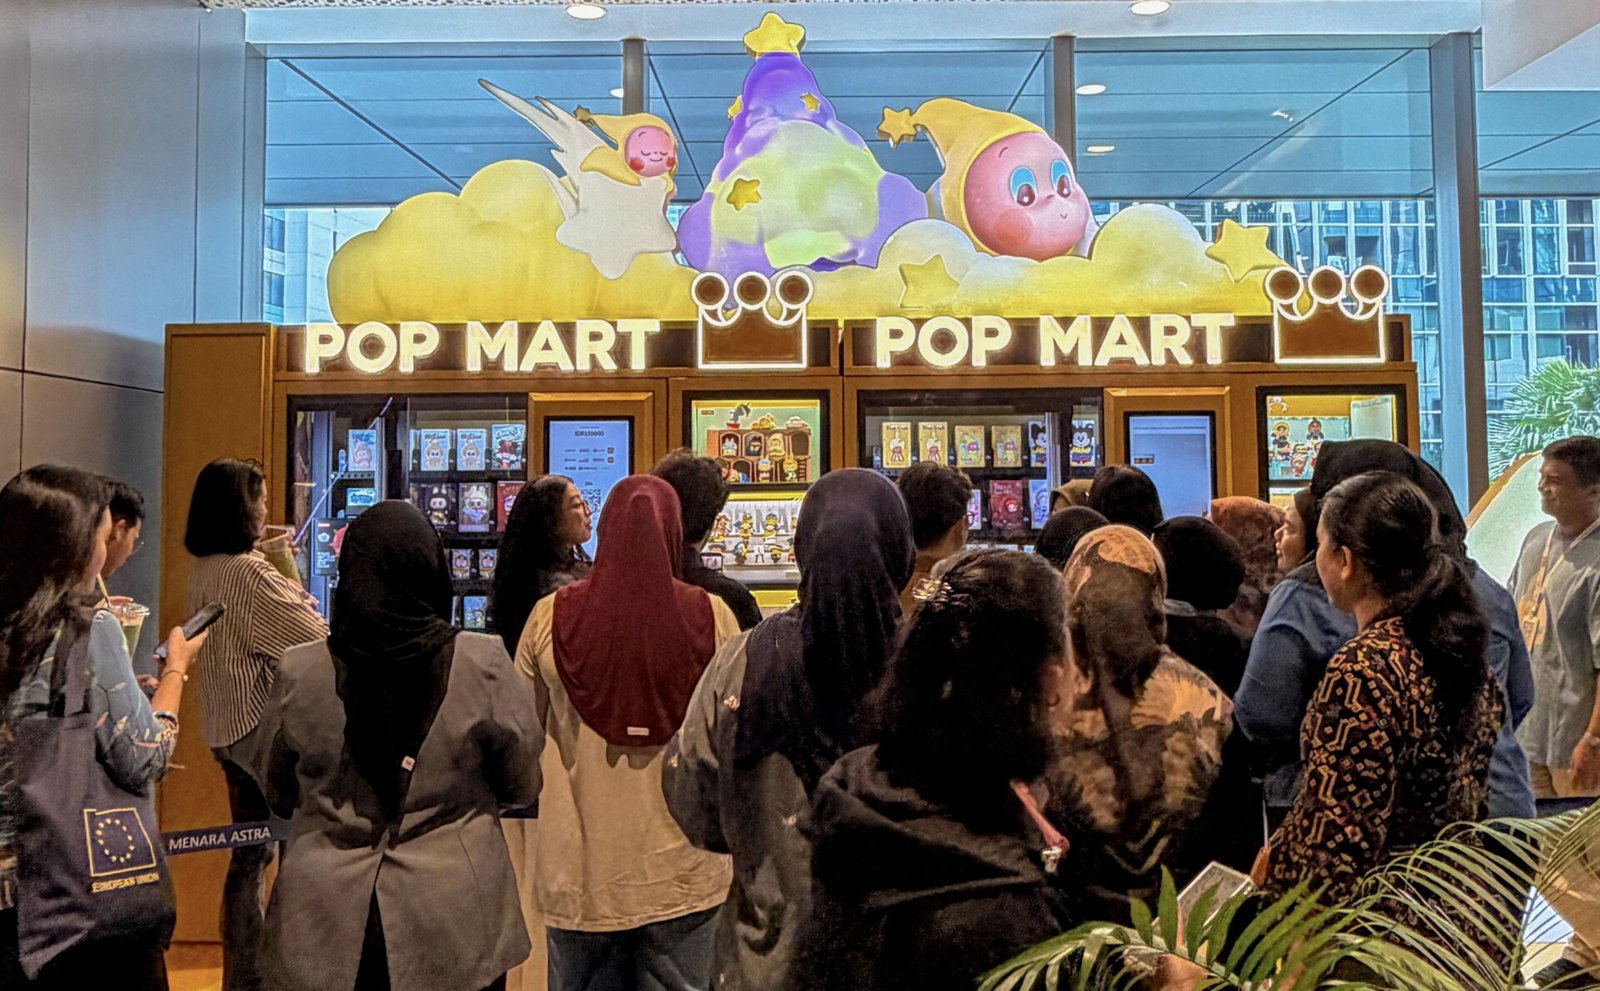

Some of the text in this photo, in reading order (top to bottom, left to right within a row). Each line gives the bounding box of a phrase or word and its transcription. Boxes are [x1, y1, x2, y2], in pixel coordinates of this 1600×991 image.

[304, 319, 661, 374] POP MART
[875, 313, 1236, 368] POP MART
[168, 826, 272, 851] MENARA ASTRA
